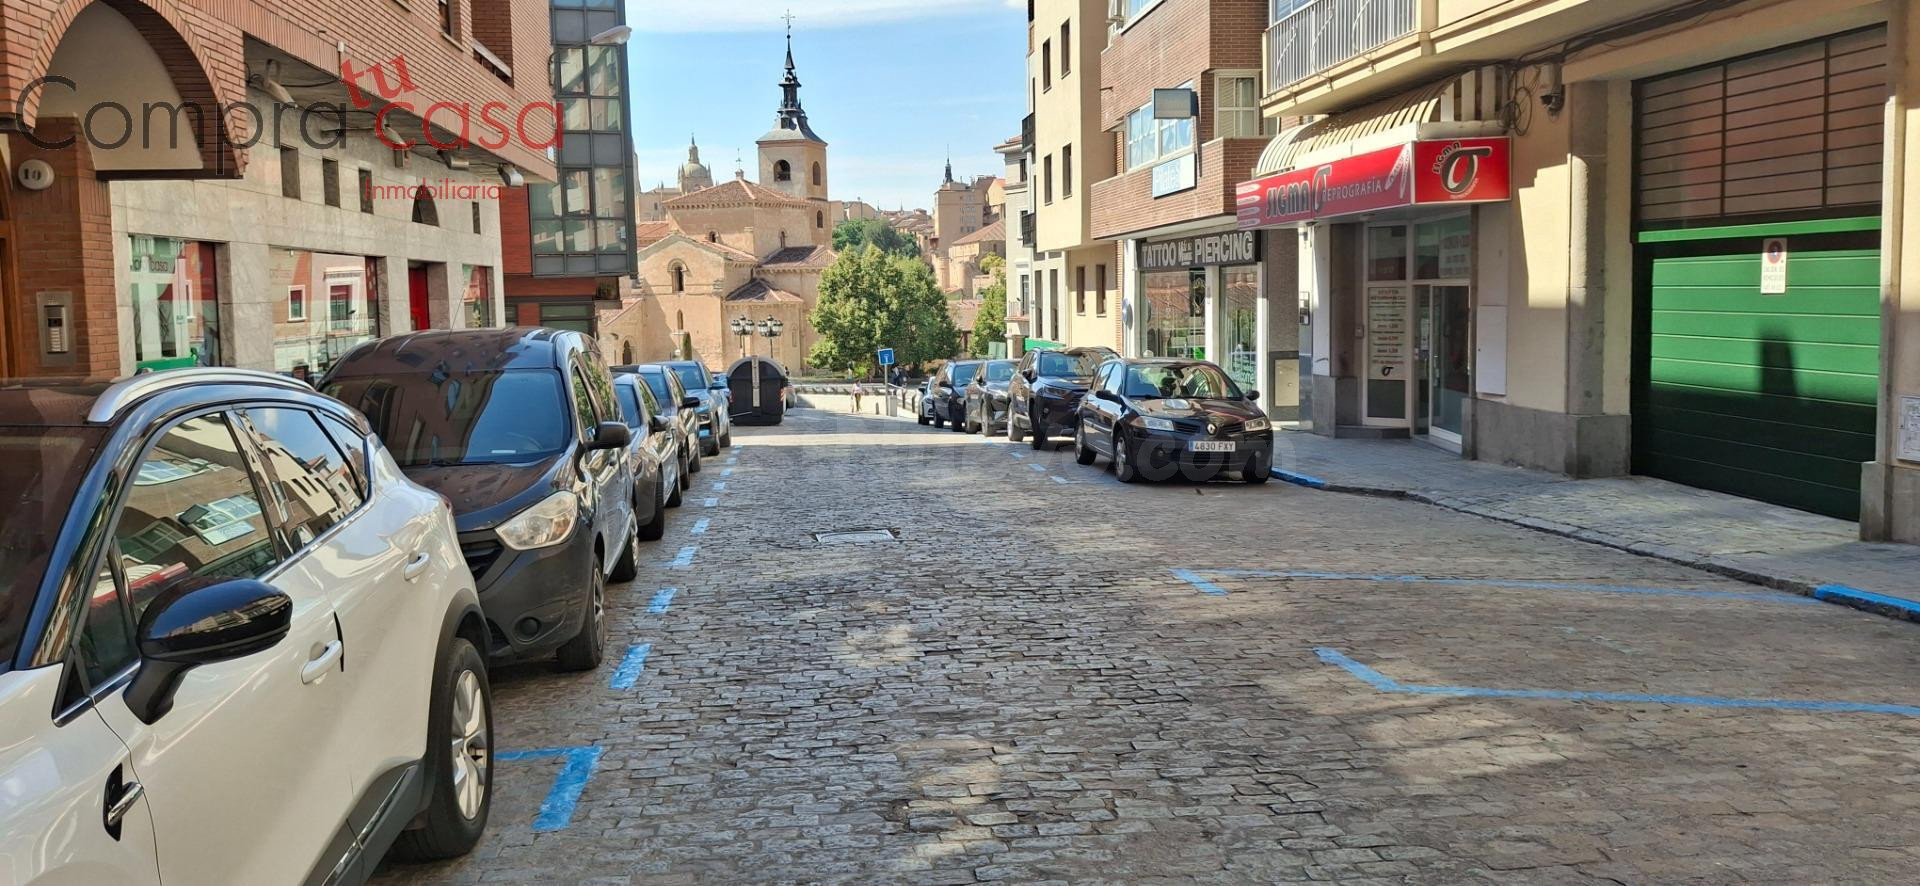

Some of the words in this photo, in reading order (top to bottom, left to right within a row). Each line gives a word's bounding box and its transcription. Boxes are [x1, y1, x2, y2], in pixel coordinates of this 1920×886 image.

[24, 168, 42, 180] 10
[1142, 241, 1177, 268] TATTOO
[1194, 231, 1253, 264] PIERCING
[1194, 442, 1216, 451] 4830
[1218, 442, 1235, 451] FXY
